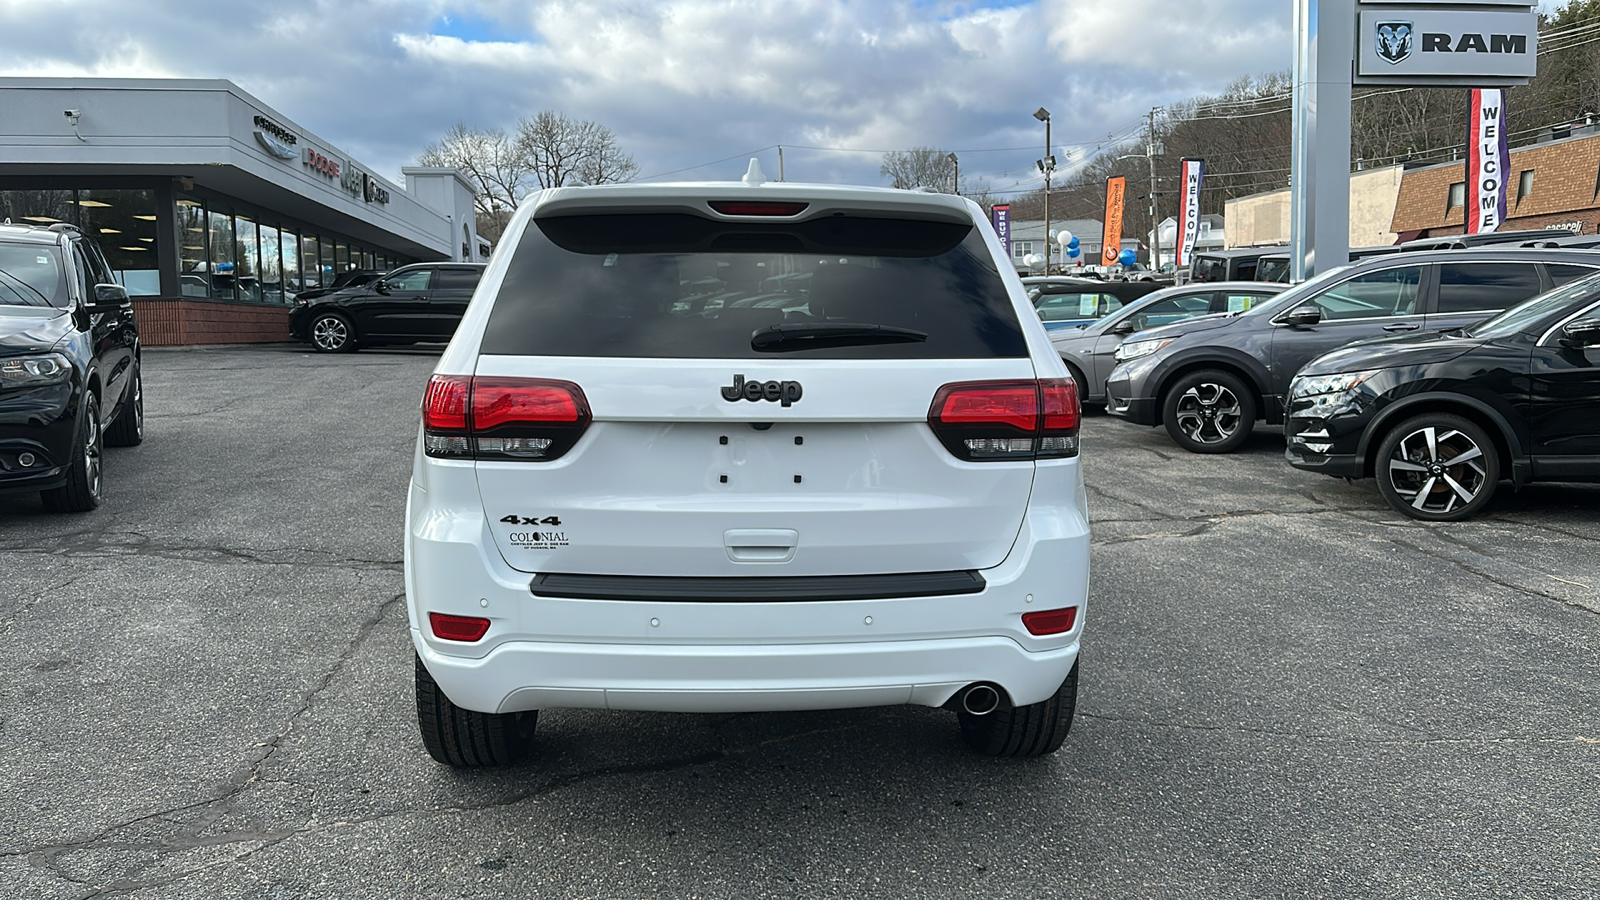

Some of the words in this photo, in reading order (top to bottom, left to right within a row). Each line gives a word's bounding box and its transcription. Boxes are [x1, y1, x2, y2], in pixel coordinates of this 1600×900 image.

[1421, 33, 1527, 54] RAM
[306, 147, 340, 179] DODGE
[1482, 106, 1498, 227] WELCOME
[1184, 174, 1199, 253] WELCOME
[720, 373, 803, 408] Jeep
[499, 514, 562, 526] 4x4
[509, 531, 569, 542] COLONIAL
